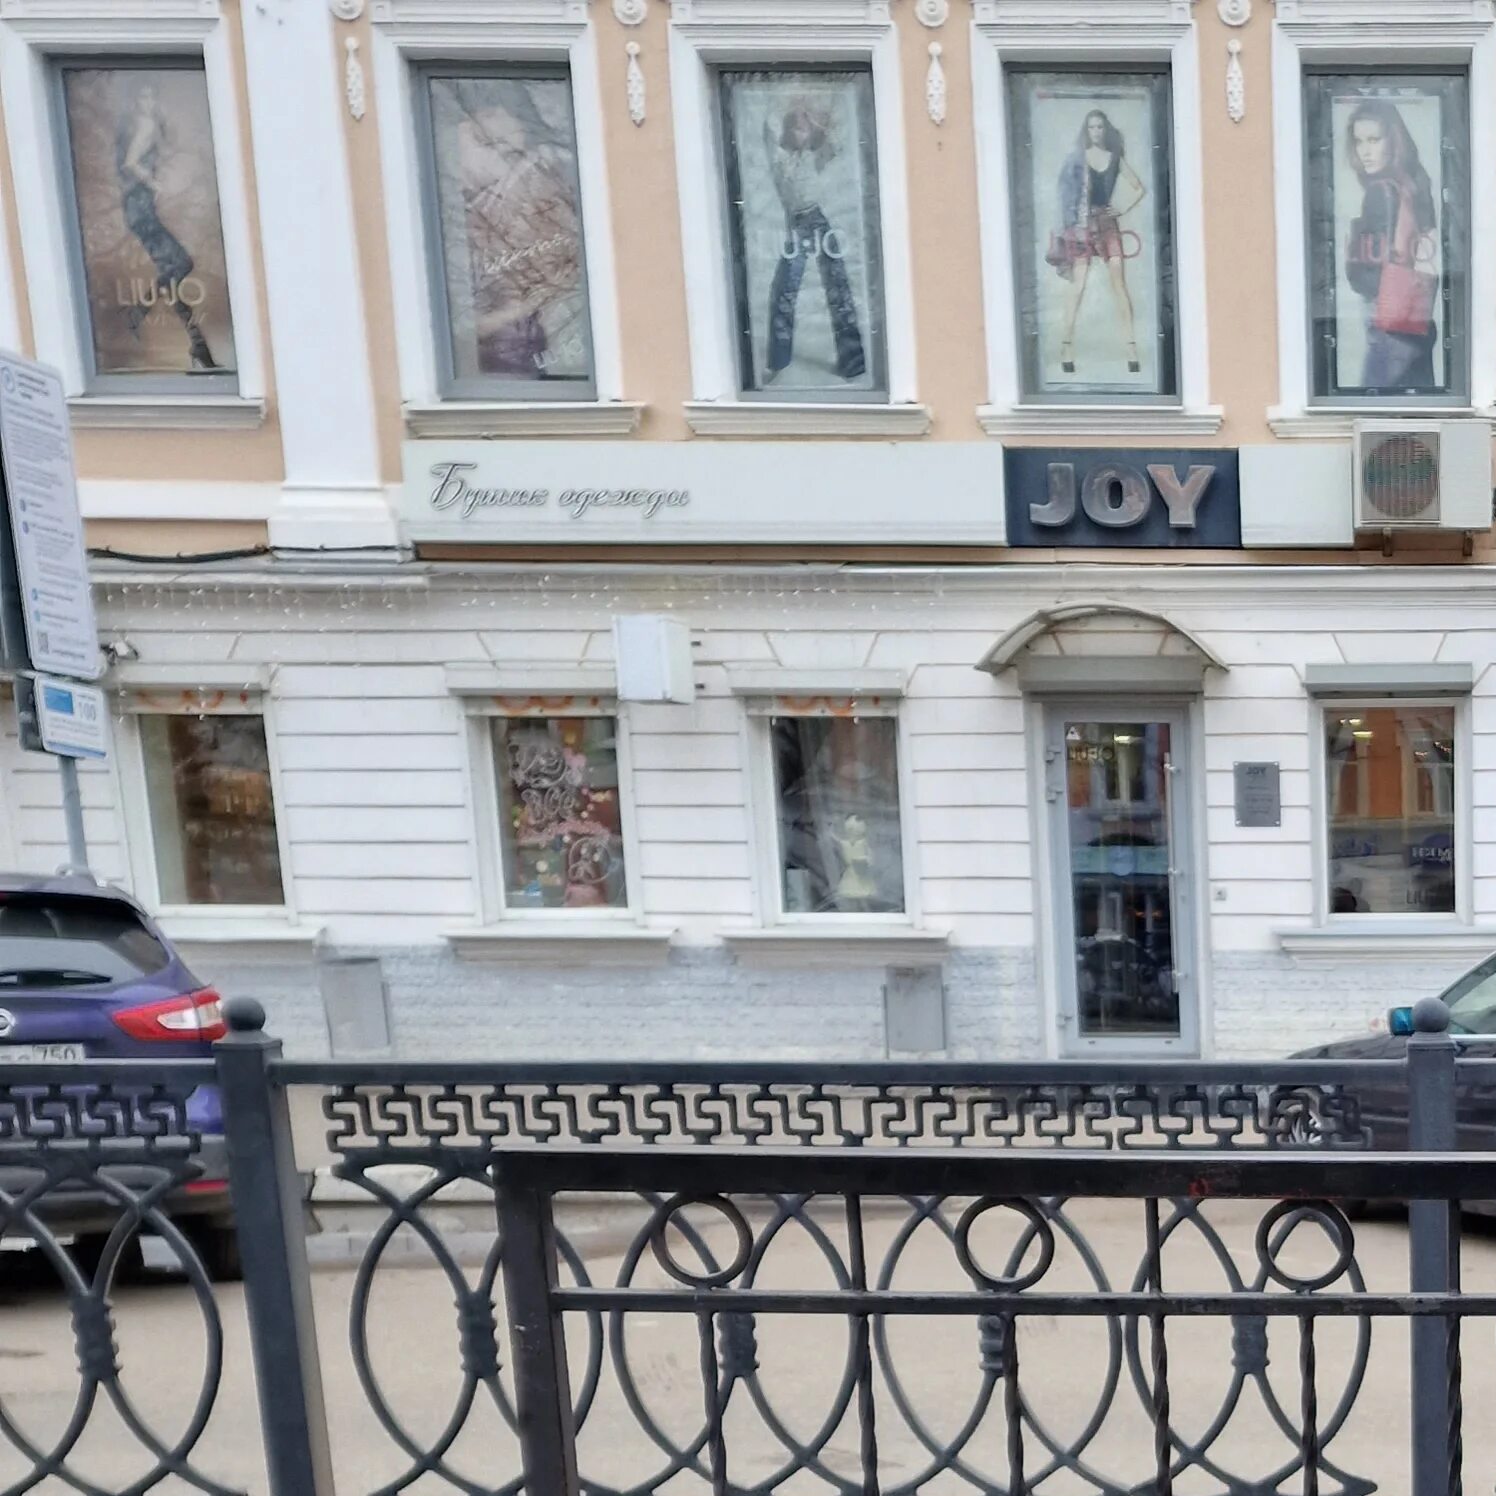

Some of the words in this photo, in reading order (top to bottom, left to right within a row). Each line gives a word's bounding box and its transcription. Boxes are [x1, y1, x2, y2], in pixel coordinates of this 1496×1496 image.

[430, 462, 549, 519] Бутик
[558, 487, 691, 520] одежды
[1029, 462, 1216, 529] JOY
